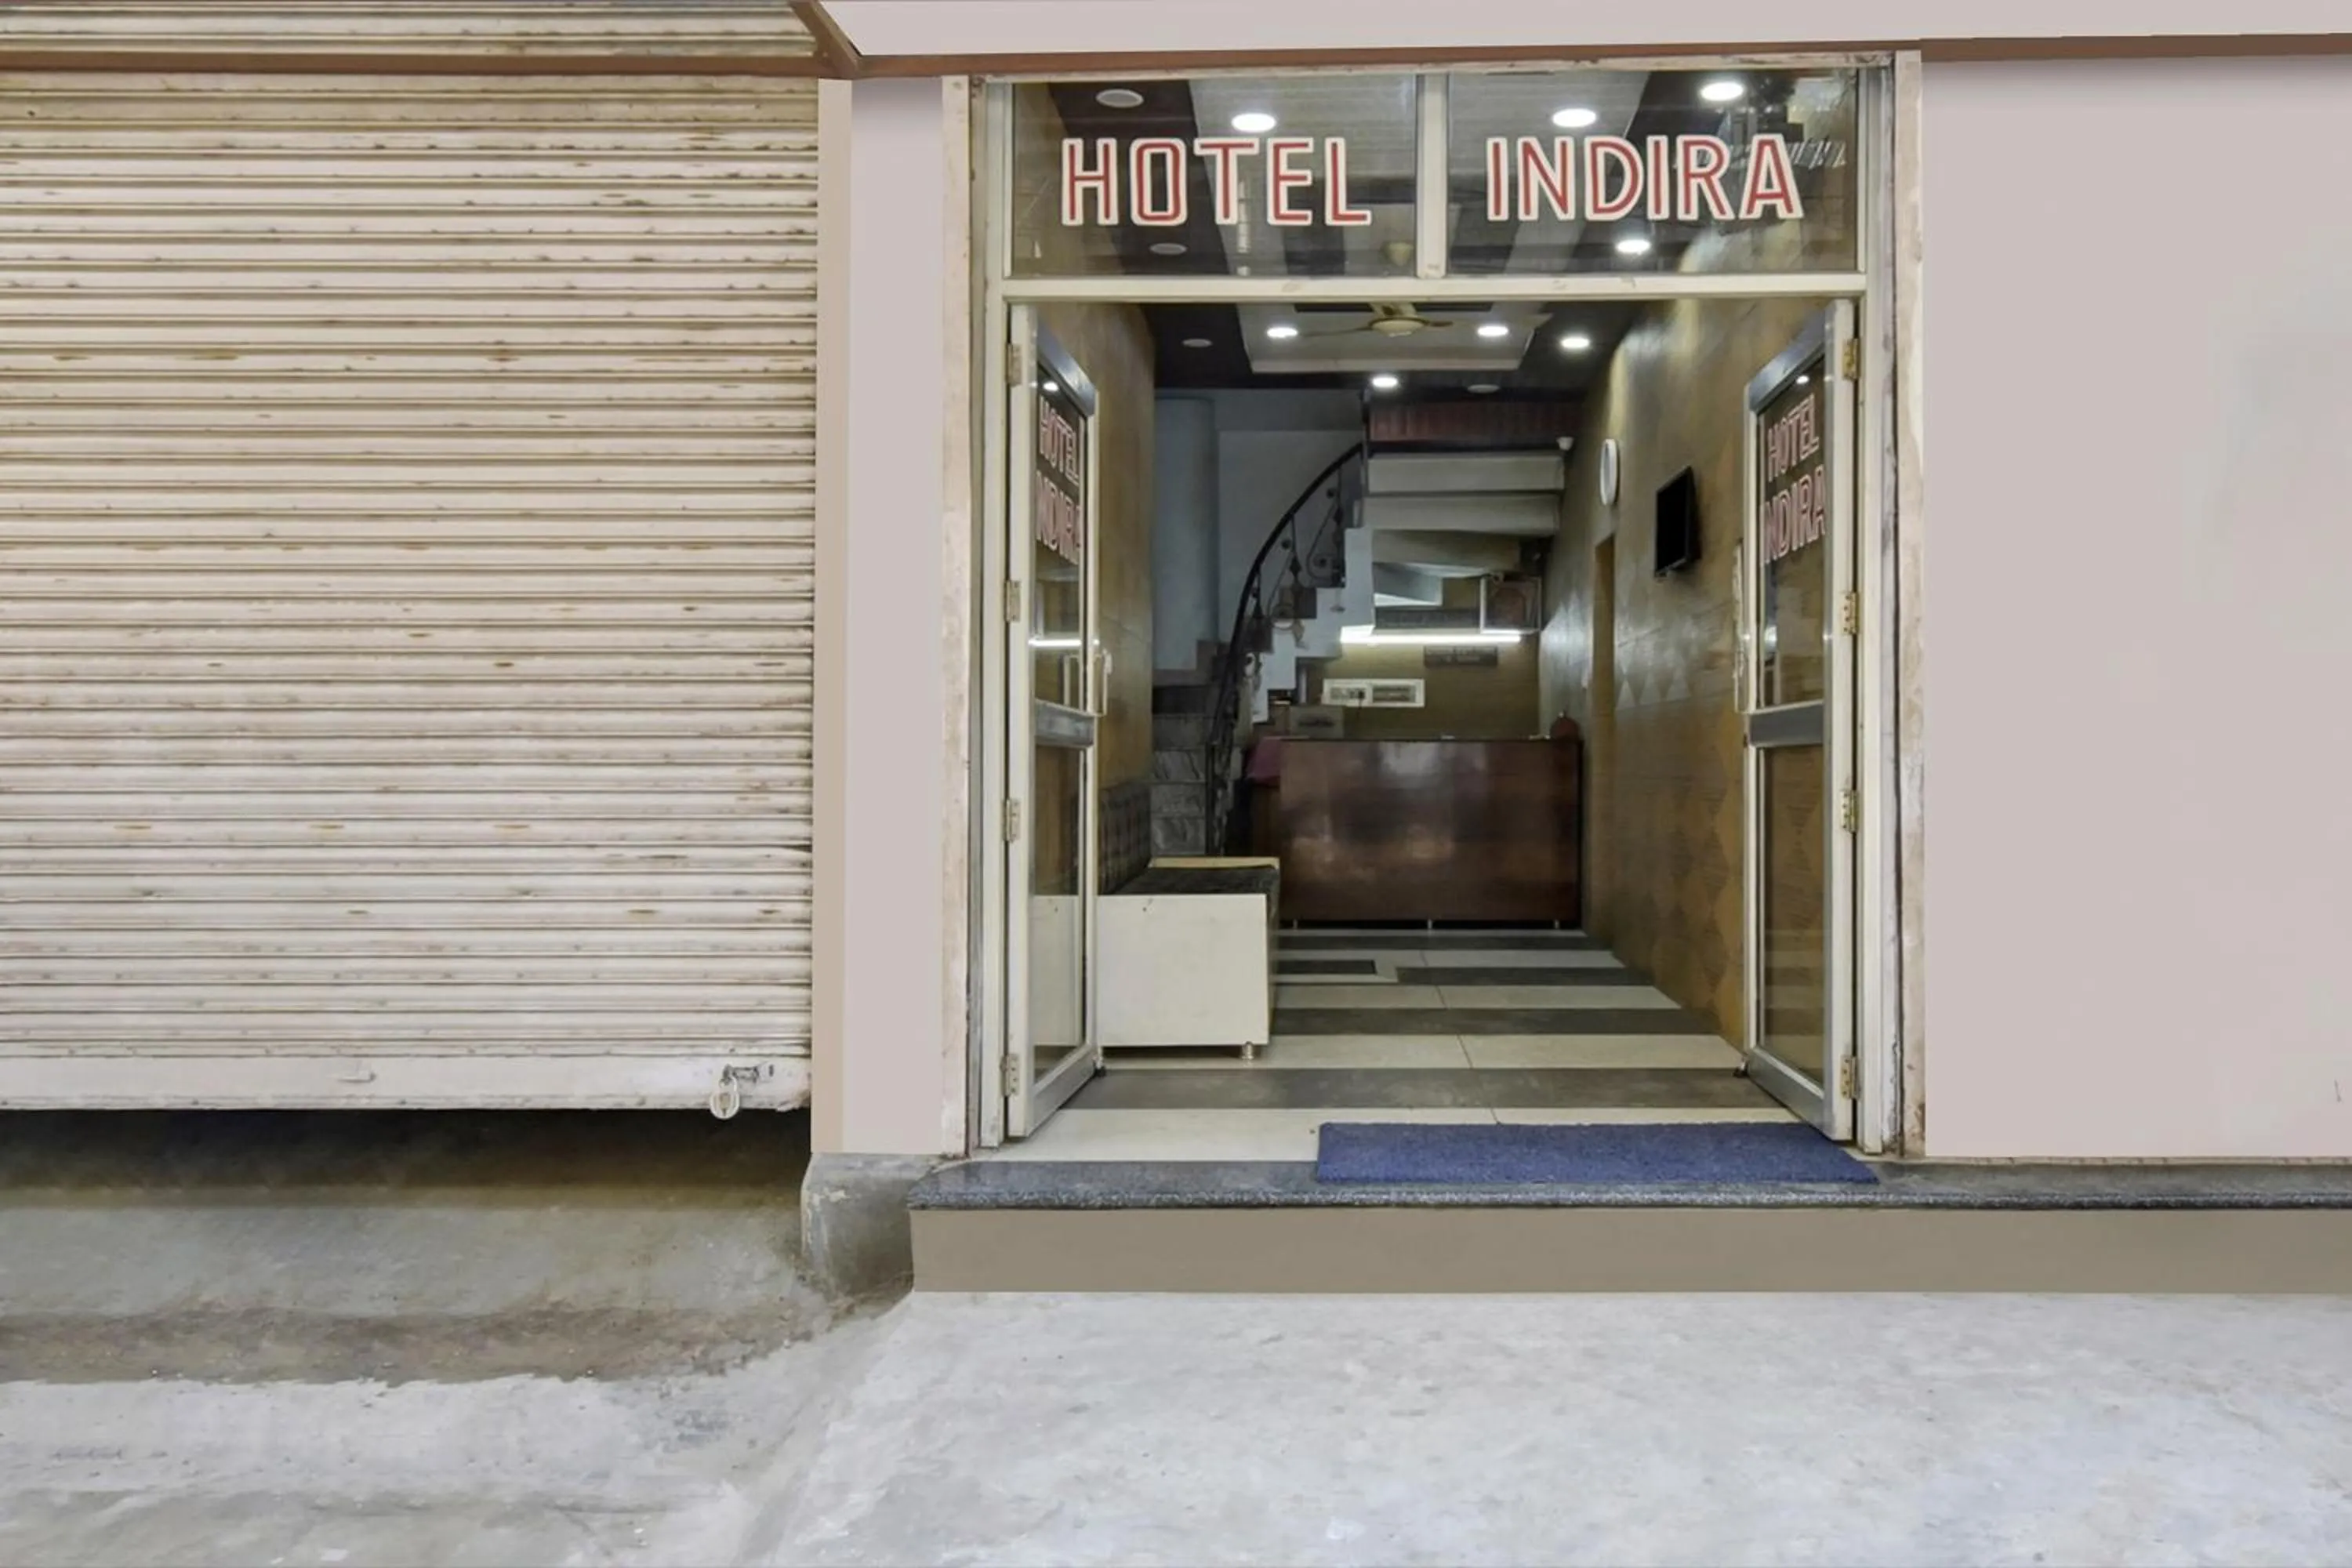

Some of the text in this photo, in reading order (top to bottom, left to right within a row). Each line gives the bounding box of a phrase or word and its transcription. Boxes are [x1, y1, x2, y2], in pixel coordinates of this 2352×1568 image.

[1062, 133, 1804, 226] HOTEL INDIRA
[1039, 394, 1080, 487] HOTEL
[1767, 393, 1820, 483] HOTEL
